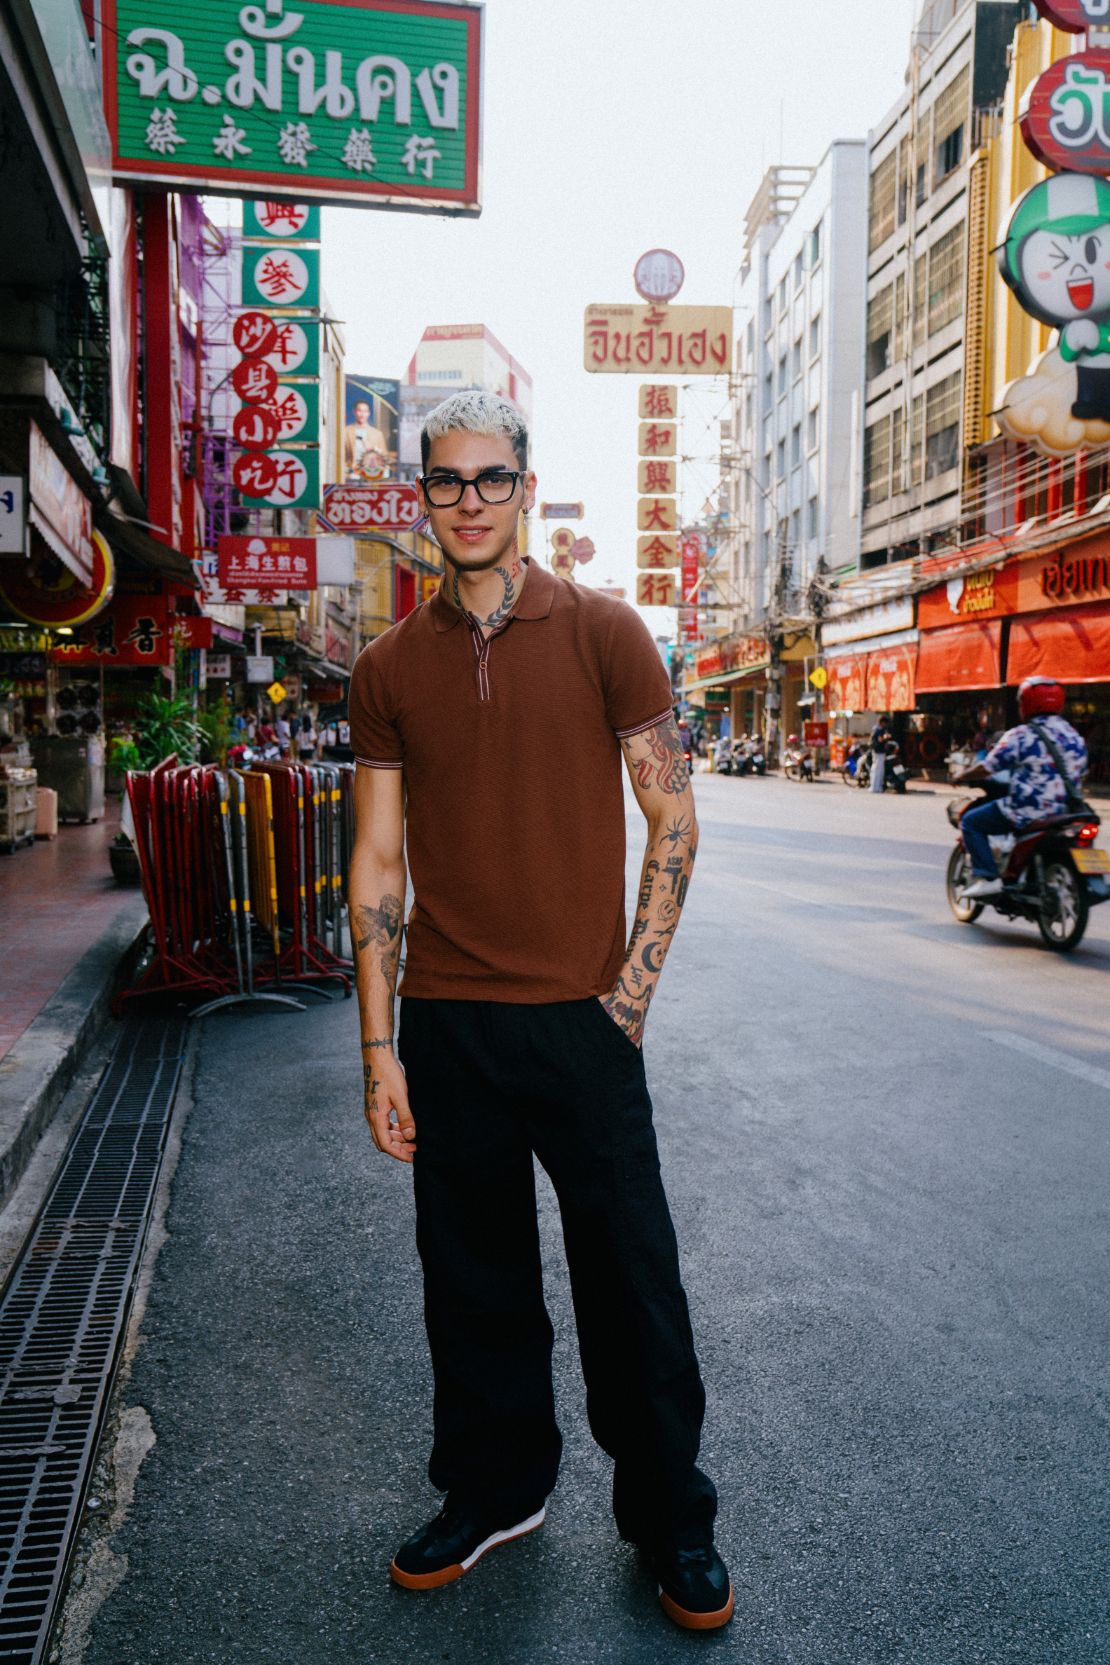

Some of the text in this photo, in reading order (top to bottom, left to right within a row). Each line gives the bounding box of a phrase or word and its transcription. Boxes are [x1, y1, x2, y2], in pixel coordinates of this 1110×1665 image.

[145, 107, 443, 180] 蔡永發藥行
[238, 317, 273, 490] 沙县小吃
[639, 860, 660, 910] Carpe
